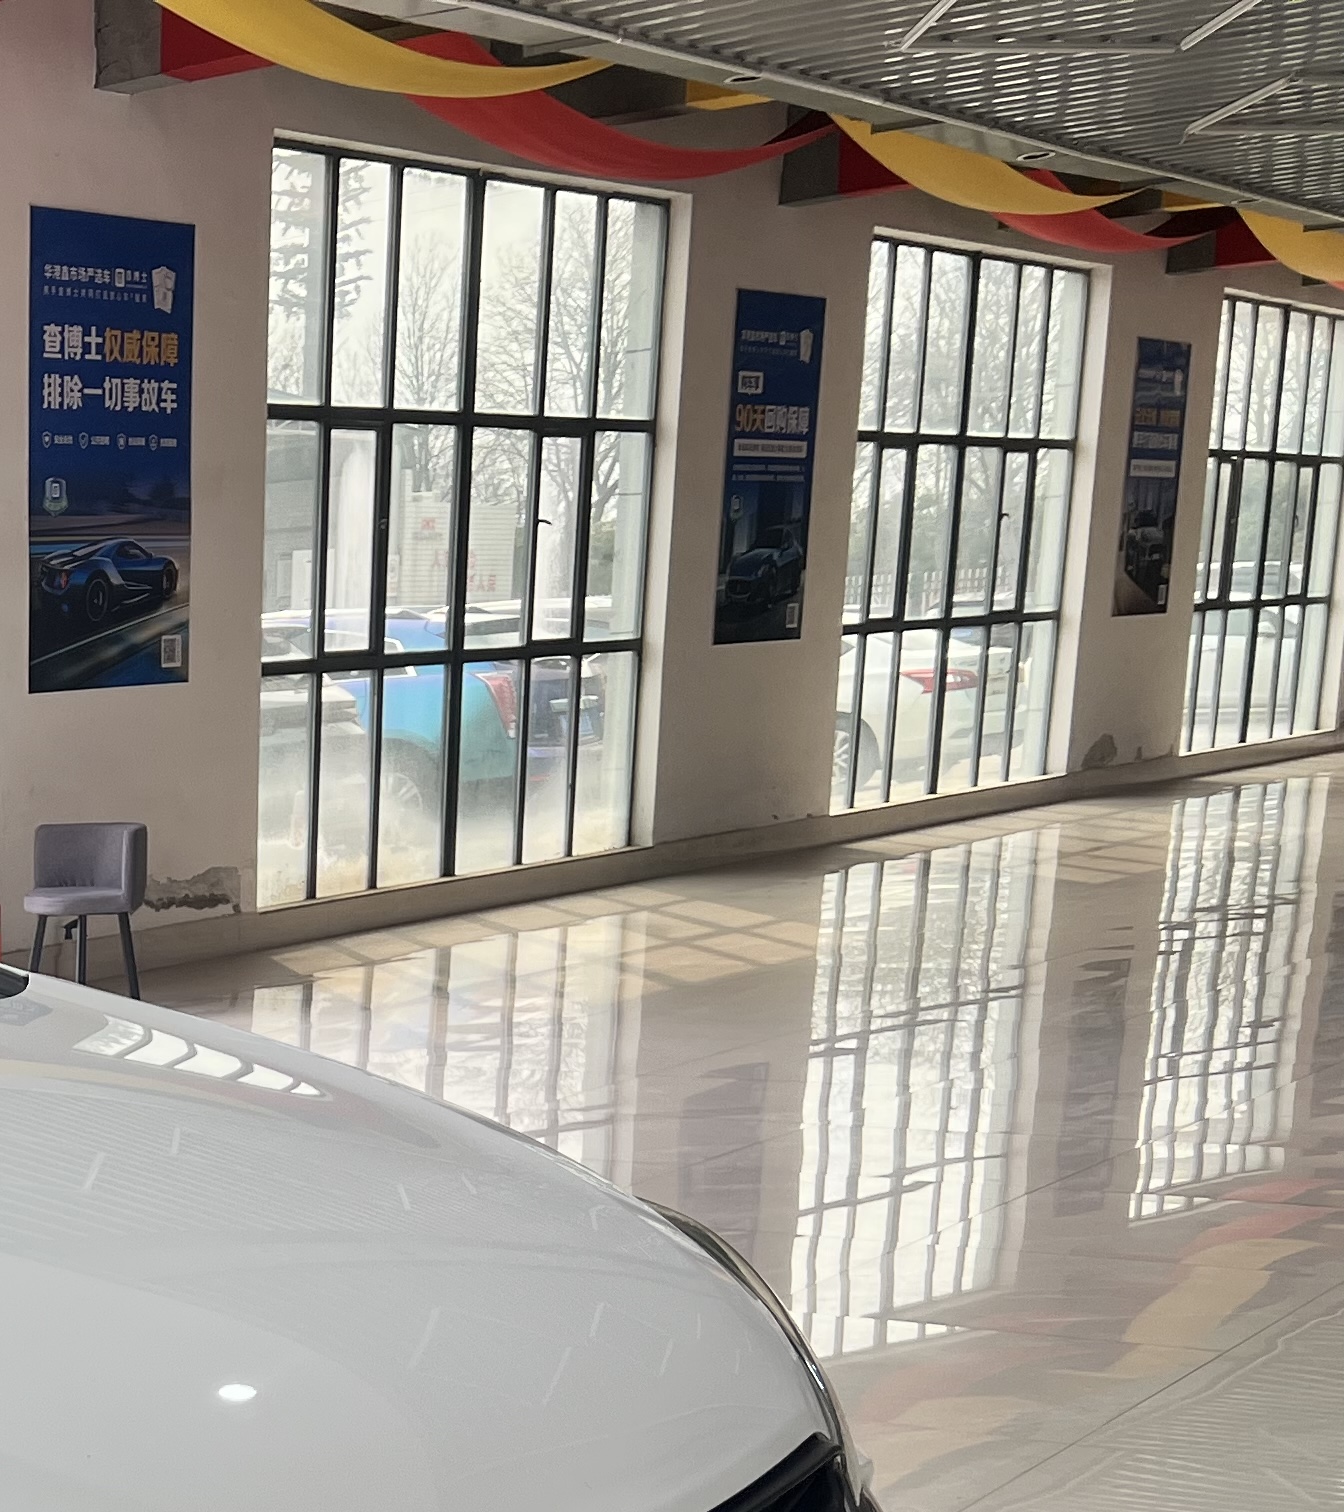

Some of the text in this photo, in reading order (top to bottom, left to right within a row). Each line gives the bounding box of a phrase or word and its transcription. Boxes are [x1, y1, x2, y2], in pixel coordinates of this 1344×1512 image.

[42, 323, 179, 367] 查博士权威保障
[42, 373, 178, 414] 排除一切事故车
